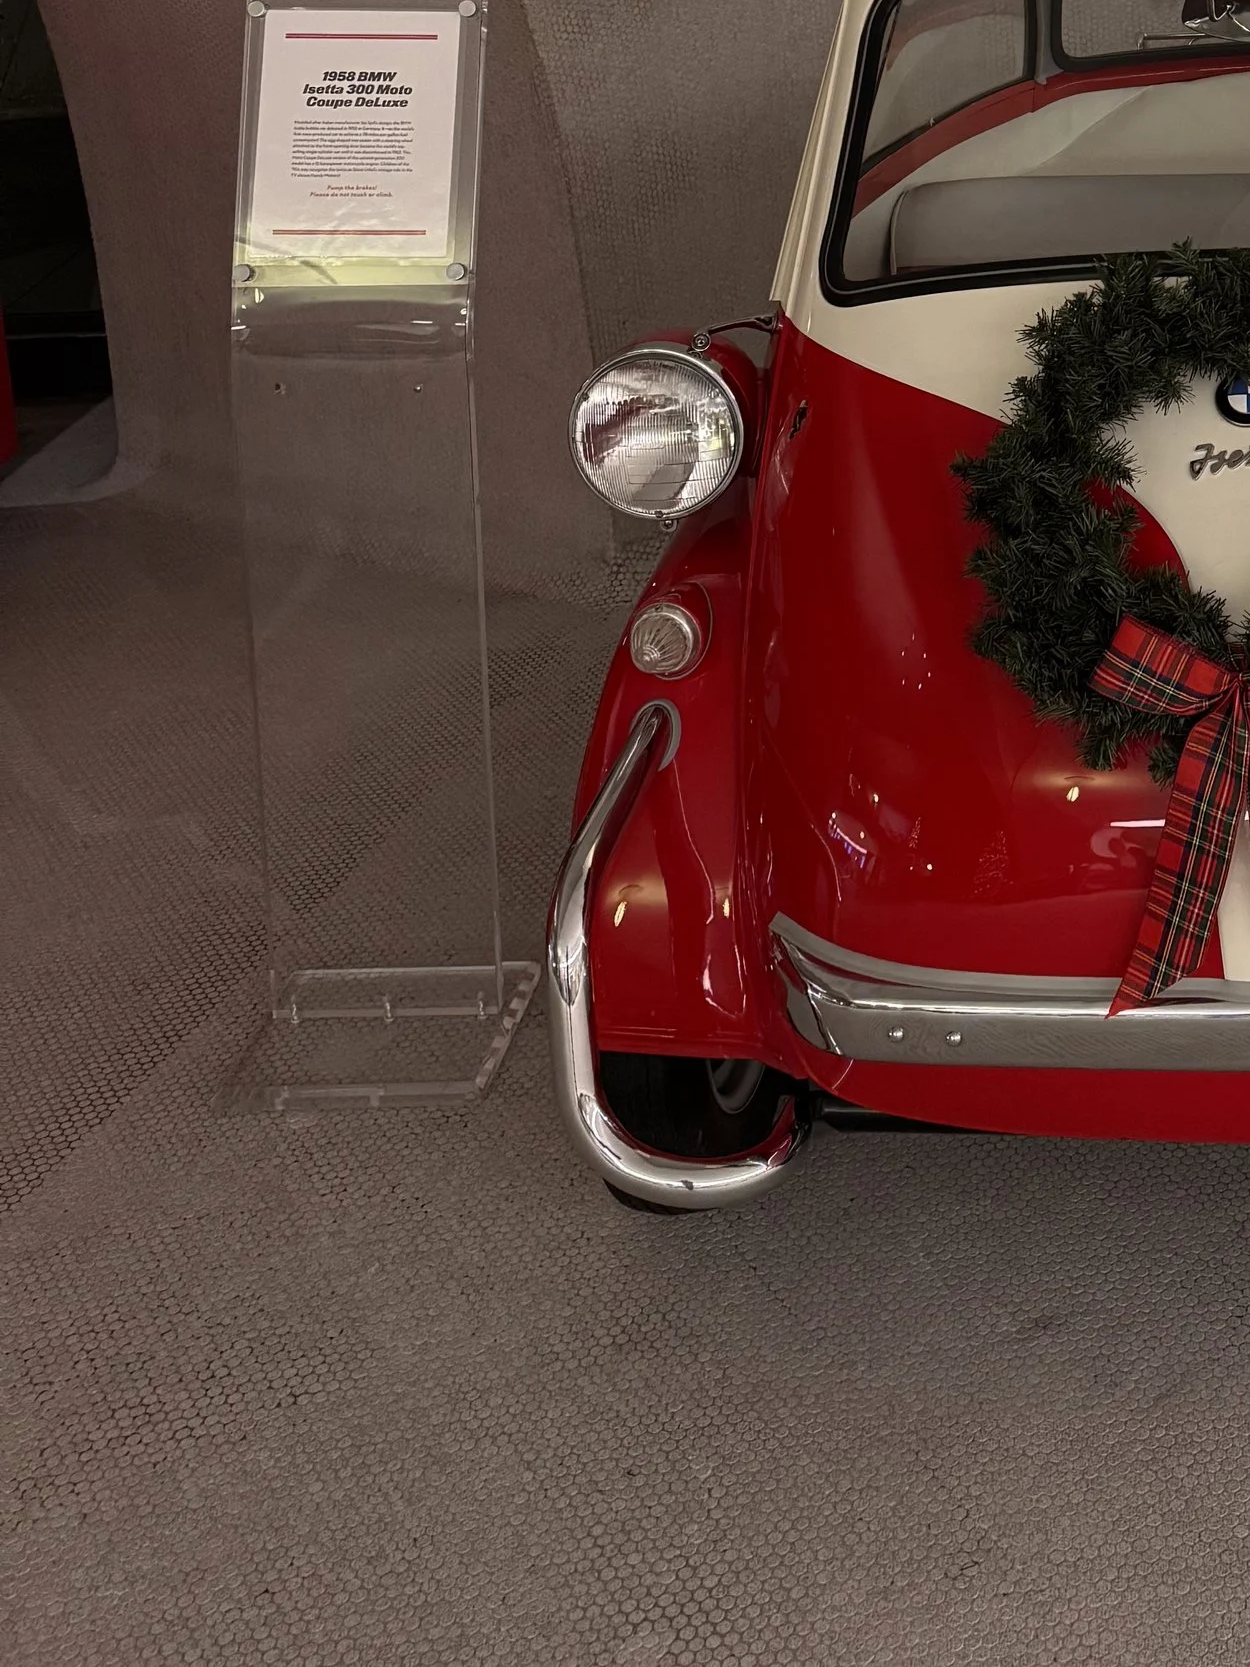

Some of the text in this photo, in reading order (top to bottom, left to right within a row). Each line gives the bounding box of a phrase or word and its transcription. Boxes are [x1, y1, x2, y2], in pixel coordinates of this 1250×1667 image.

[323, 71, 397, 81] 1958 BMW
[303, 84, 412, 95] Isetta 300 Moto
[306, 96, 408, 109] Coupe DeLuxe
